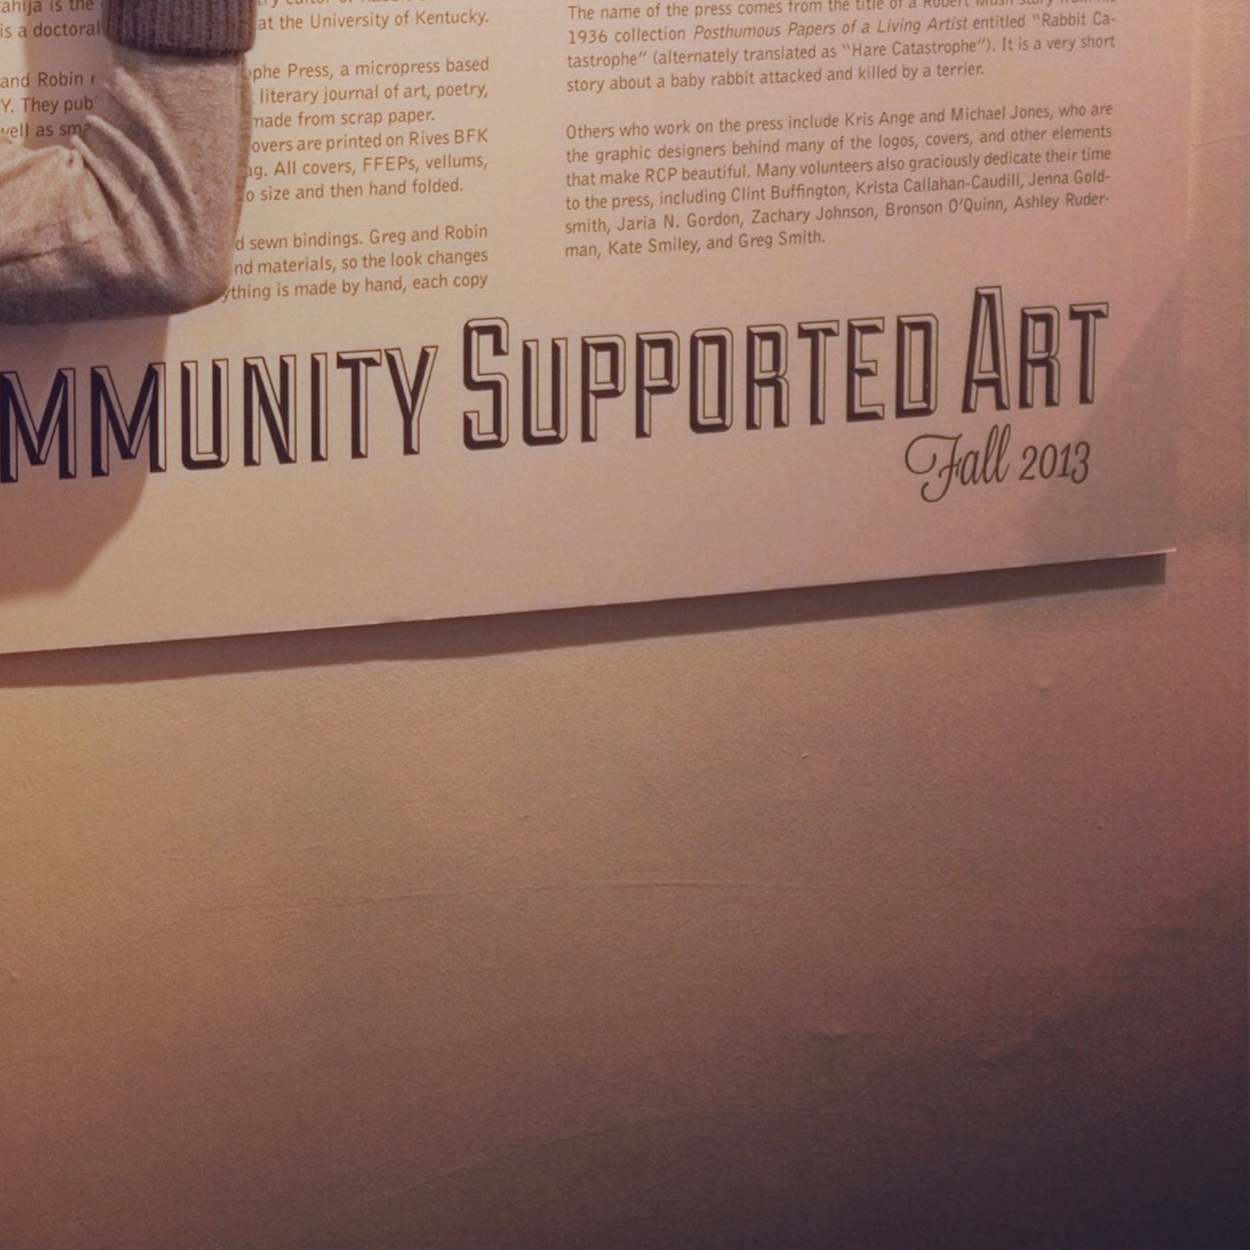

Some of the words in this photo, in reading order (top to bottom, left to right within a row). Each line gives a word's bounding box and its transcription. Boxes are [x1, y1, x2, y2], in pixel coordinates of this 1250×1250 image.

[32, 21, 99, 37] doctoral
[310, 11, 389, 29] University
[415, 8, 488, 26] Kentucky.
[600, 6, 640, 19] name
[694, 3, 732, 18] press
[737, 1, 782, 15] comes
[568, 29, 607, 44] 1936
[614, 26, 685, 43] collection
[693, 24, 780, 39] Posthumous
[787, 21, 835, 38] Papers
[876, 17, 921, 34] Living
[926, 15, 967, 30] Artist
[972, 13, 1025, 29] entitled
[652, 47, 738, 65] (alternately
[743, 44, 816, 61] translated
[1046, 38, 1076, 52] very
[1080, 34, 1115, 48] short
[37, 70, 83, 87] Robin
[287, 62, 333, 79] Press,
[355, 60, 440, 77] micropress
[445, 55, 489, 72] based
[566, 78, 605, 93] story
[608, 75, 652, 90] about
[670, 72, 706, 89] baby
[710, 70, 755, 85] rabbit
[759, 67, 822, 84] attacked
[858, 64, 897, 79] killed
[936, 61, 984, 77] terrier.
[20, 96, 59, 115] They
[259, 88, 319, 105] literary
[322, 84, 378, 104] journal
[402, 83, 431, 100] art,
[436, 82, 488, 99] poetry,
[297, 110, 335, 126] from
[340, 111, 383, 126] scrap
[387, 110, 435, 126] paper.
[565, 123, 615, 139] Others
[653, 119, 690, 135] work
[745, 118, 783, 134] press
[788, 112, 839, 129] include
[844, 111, 874, 126] Kris
[877, 110, 915, 127] Ange
[950, 105, 1005, 121] Michael
[1009, 104, 1053, 120] Jones,
[325, 132, 381, 152] printed
[408, 130, 450, 145] Rives
[594, 144, 651, 164] graphic
[657, 143, 726, 160] designers
[731, 138, 780, 155] behind
[785, 140, 825, 154] many
[878, 133, 918, 150] logos,
[924, 133, 973, 146] covers,
[1010, 127, 1047, 142] other
[1051, 125, 1112, 139] elements
[302, 161, 356, 176] covers,
[363, 155, 419, 173] FFEPs,
[425, 153, 487, 170] vellums,
[565, 171, 596, 187] that
[599, 169, 640, 184] make
[681, 163, 750, 181] beautiful.
[756, 162, 796, 178] Many
[799, 160, 873, 175] volunteers
[876, 156, 905, 171] also
[908, 152, 980, 172] graciously
[983, 150, 1041, 166] dedicate
[1045, 147, 1078, 163] their
[260, 185, 290, 201] size
[329, 182, 363, 198] then
[368, 179, 406, 195] hand
[411, 177, 463, 193] folded.
[611, 194, 654, 211] press,
[659, 188, 726, 205] including
[730, 186, 766, 202] Clint
[770, 183, 850, 200] Buffington,
[855, 180, 898, 195] Krista
[903, 172, 1024, 193] Callahan-Caudill,
[1027, 172, 1069, 186] Jenna
[1073, 168, 1110, 184] Gold-
[564, 217, 611, 235] smith,
[616, 215, 656, 231] Jaria
[686, 211, 744, 228] Gordon,
[750, 208, 811, 224] Zachary
[815, 205, 878, 220] Johnson,
[885, 201, 942, 216] Bronson
[1013, 194, 1059, 210] Ashley
[1065, 191, 1109, 206] Ruder-
[249, 236, 287, 250] sewn
[292, 231, 363, 248] bindings.
[369, 228, 405, 245] Greg
[444, 223, 487, 239] Robin
[647, 236, 701, 254] Smiley,
[778, 229, 825, 245] Smith.
[257, 255, 336, 273] materials,
[390, 250, 422, 266] look
[426, 249, 488, 266] changes
[294, 279, 336, 296] made
[364, 275, 406, 293] hand,
[412, 273, 447, 289] each
[452, 274, 488, 289] copy
[905, 423, 1011, 503] Fall
[1018, 441, 1090, 484] 2013
